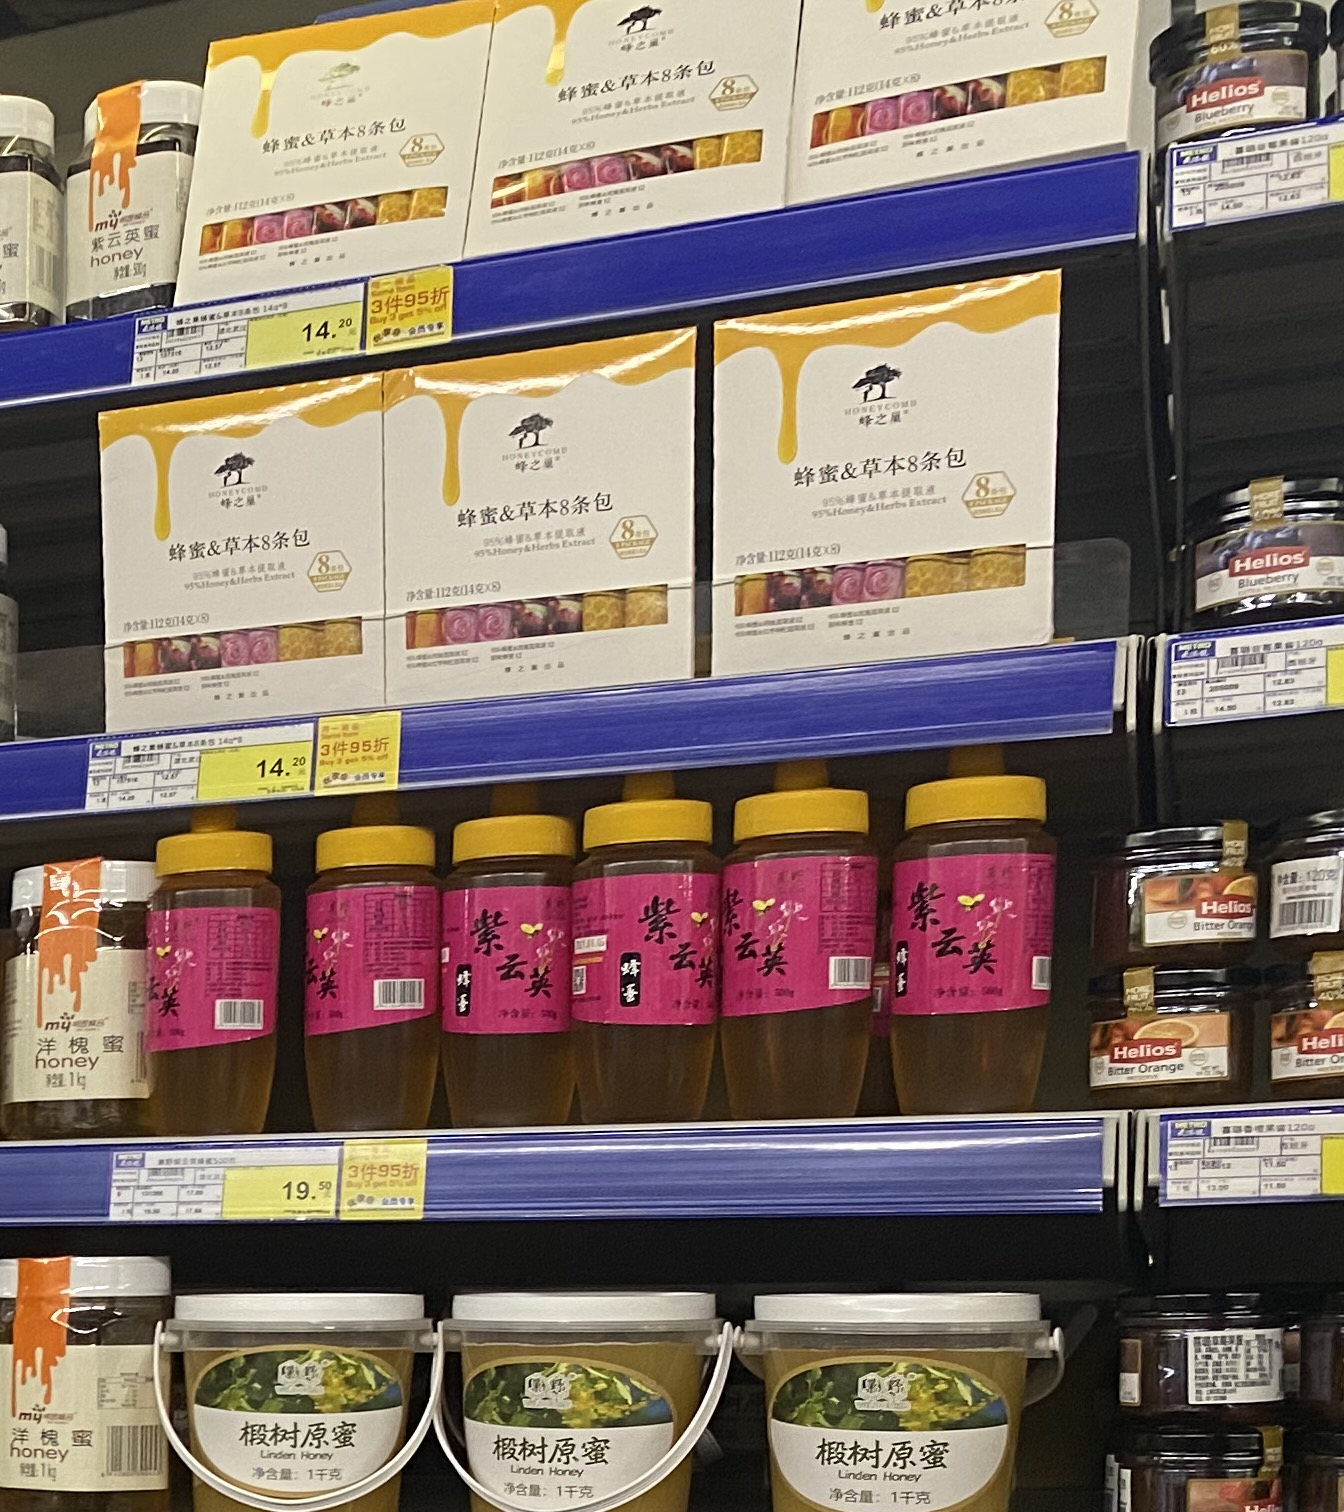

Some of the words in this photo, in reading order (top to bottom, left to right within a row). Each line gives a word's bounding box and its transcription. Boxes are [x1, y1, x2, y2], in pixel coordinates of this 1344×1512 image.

[557, 60, 715, 102] 蜂蜜&草本8条包
[1191, 81, 1260, 107] Helios
[1195, 103, 1254, 123] Blueberry
[262, 117, 406, 155] 蜂蜜&草本8条包
[91, 224, 160, 252] 紫云英蜜
[90, 247, 144, 268] honey
[370, 286, 449, 313] 3件95折
[302, 318, 352, 342] 14.20
[793, 448, 968, 488] 蜂蜜&草本8条包
[457, 492, 614, 528] 蜂蜜&草本8条包
[169, 528, 311, 563] 蜂蜜&草本8条包
[1234, 552, 1306, 573] Helios
[1238, 573, 1299, 589] Blueberry
[320, 738, 390, 759] 3件95折
[257, 756, 306, 779] 14.20
[1202, 901, 1252, 915] Helios
[907, 881, 997, 975] 紫云英
[1193, 921, 1224, 931] Bitter
[470, 908, 554, 998] 紫云英
[37, 1034, 125, 1055] 洋槐蜜
[1114, 1043, 1178, 1060] Helios
[35, 1052, 100, 1071] honey
[1107, 1063, 1135, 1076] Bitter
[1138, 1061, 1184, 1074] Orange
[348, 1163, 419, 1182] 3件95折
[282, 1180, 331, 1201] 19.50
[11, 1427, 94, 1448] 洋槐蜜
[240, 1421, 358, 1449] 椴树原蜜
[9, 1444, 69, 1462] honey
[260, 1450, 295, 1461] Linden
[300, 1451, 334, 1463] Honey
[493, 1434, 612, 1467] 椴树原蜜
[815, 1437, 950, 1470] 椴树原蜜
[510, 1466, 544, 1477] Linden
[549, 1467, 585, 1479] Honey
[838, 1469, 877, 1482] Linden
[883, 1470, 922, 1484] Honey
